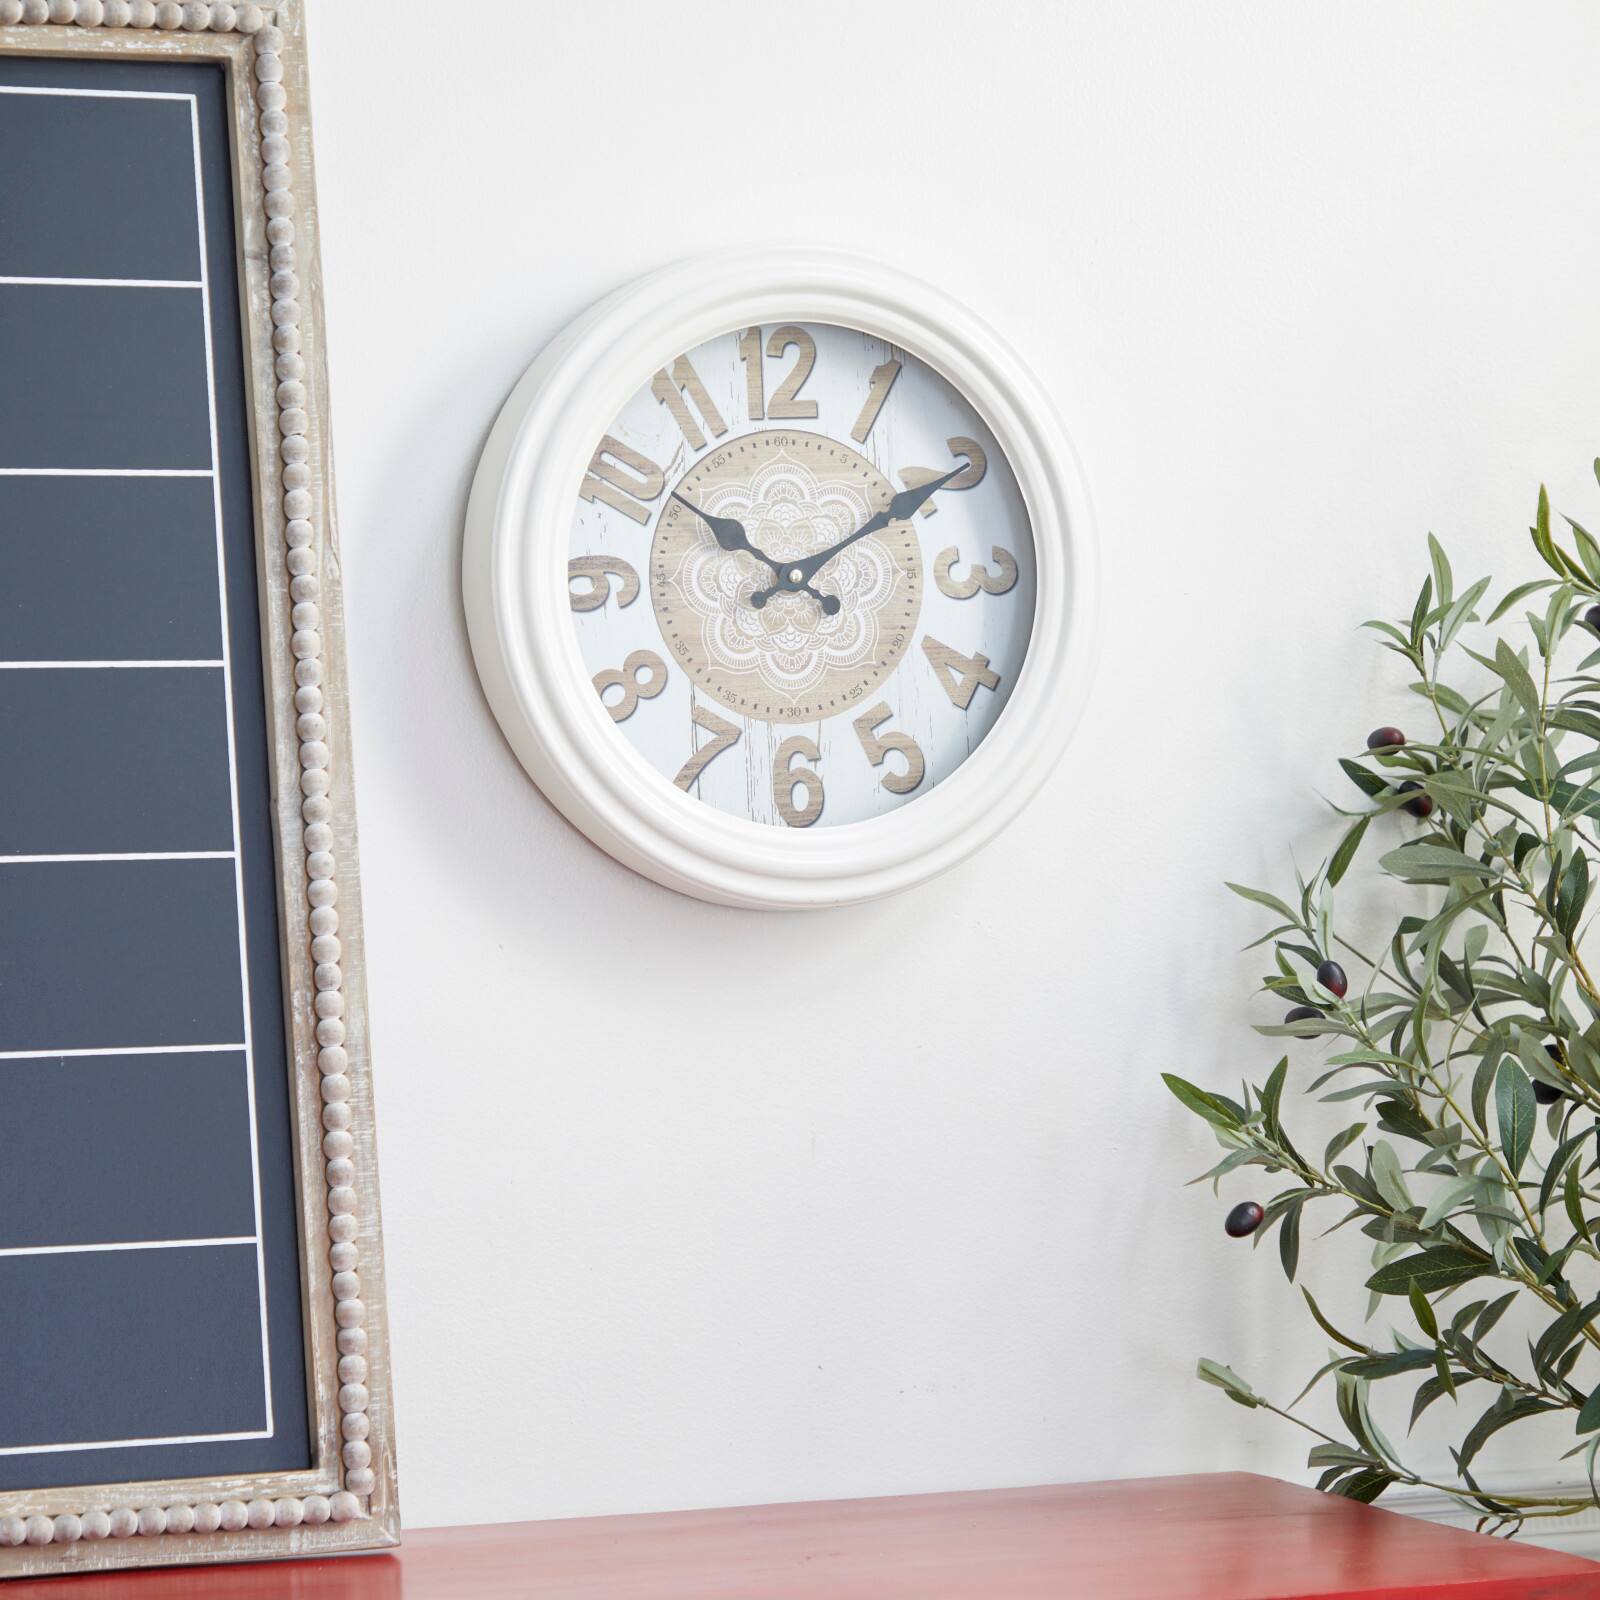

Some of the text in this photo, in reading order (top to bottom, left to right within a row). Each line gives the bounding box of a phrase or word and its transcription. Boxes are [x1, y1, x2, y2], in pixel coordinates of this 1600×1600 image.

[651, 353, 728, 451] 11
[739, 326, 819, 420] 12
[850, 359, 902, 444] 1
[711, 454, 726, 468] 55
[774, 437, 788, 447] 60
[840, 454, 848, 464] 5
[579, 434, 665, 526] 10
[669, 505, 682, 521] 50
[568, 554, 640, 612] 9
[907, 568, 917, 580] 15
[934, 545, 1018, 600] 3
[892, 633, 905, 649] 20
[593, 649, 668, 723] 8
[849, 685, 864, 699] 25
[922, 635, 1001, 710] 4
[787, 707, 801, 718] 30
[673, 705, 742, 793] 7
[853, 701, 925, 795] 5
[773, 736, 824, 828] 6
